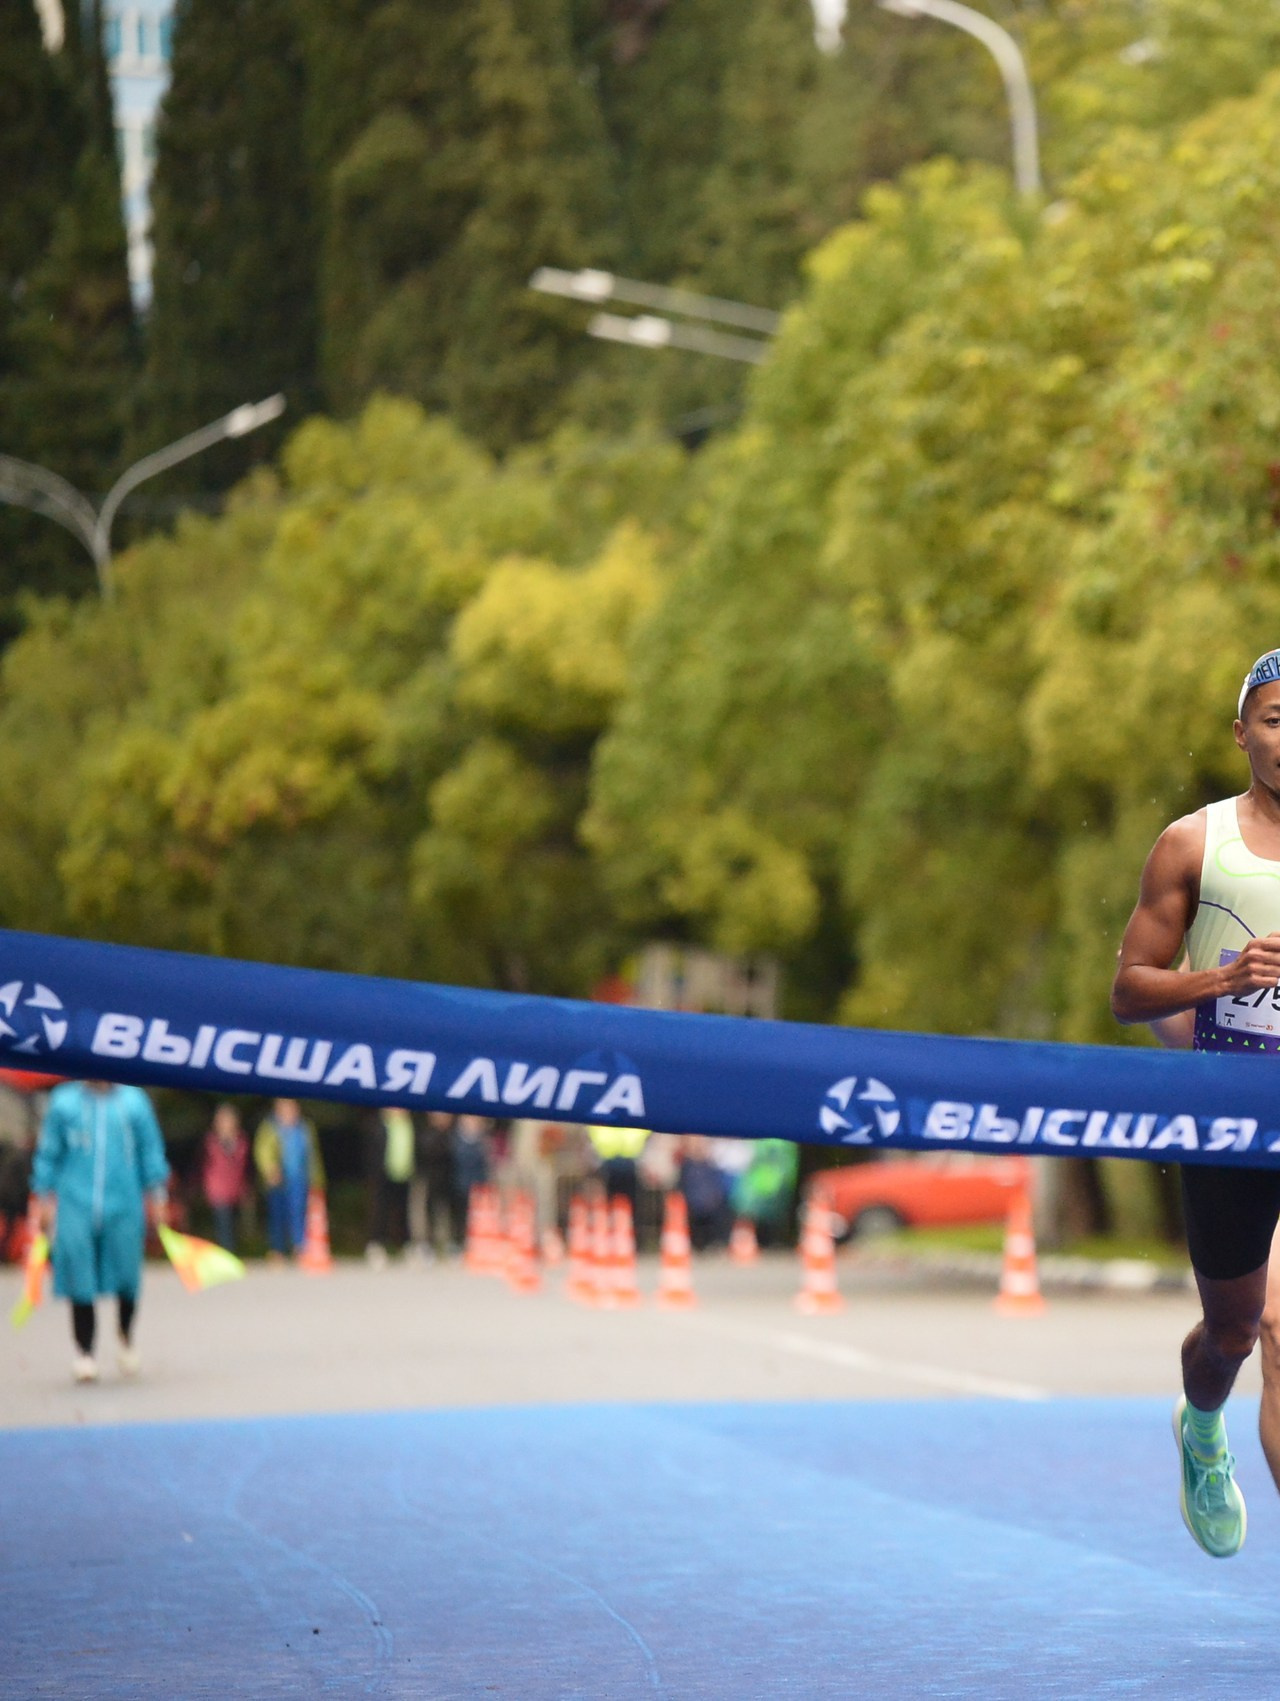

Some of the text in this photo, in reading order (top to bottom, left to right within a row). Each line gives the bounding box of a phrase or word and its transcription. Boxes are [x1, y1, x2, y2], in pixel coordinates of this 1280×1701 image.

[91, 1012, 646, 1118] ВЫСШАЯ ЛИГА
[922, 1100, 1258, 1152] ВЫСШАЯ
